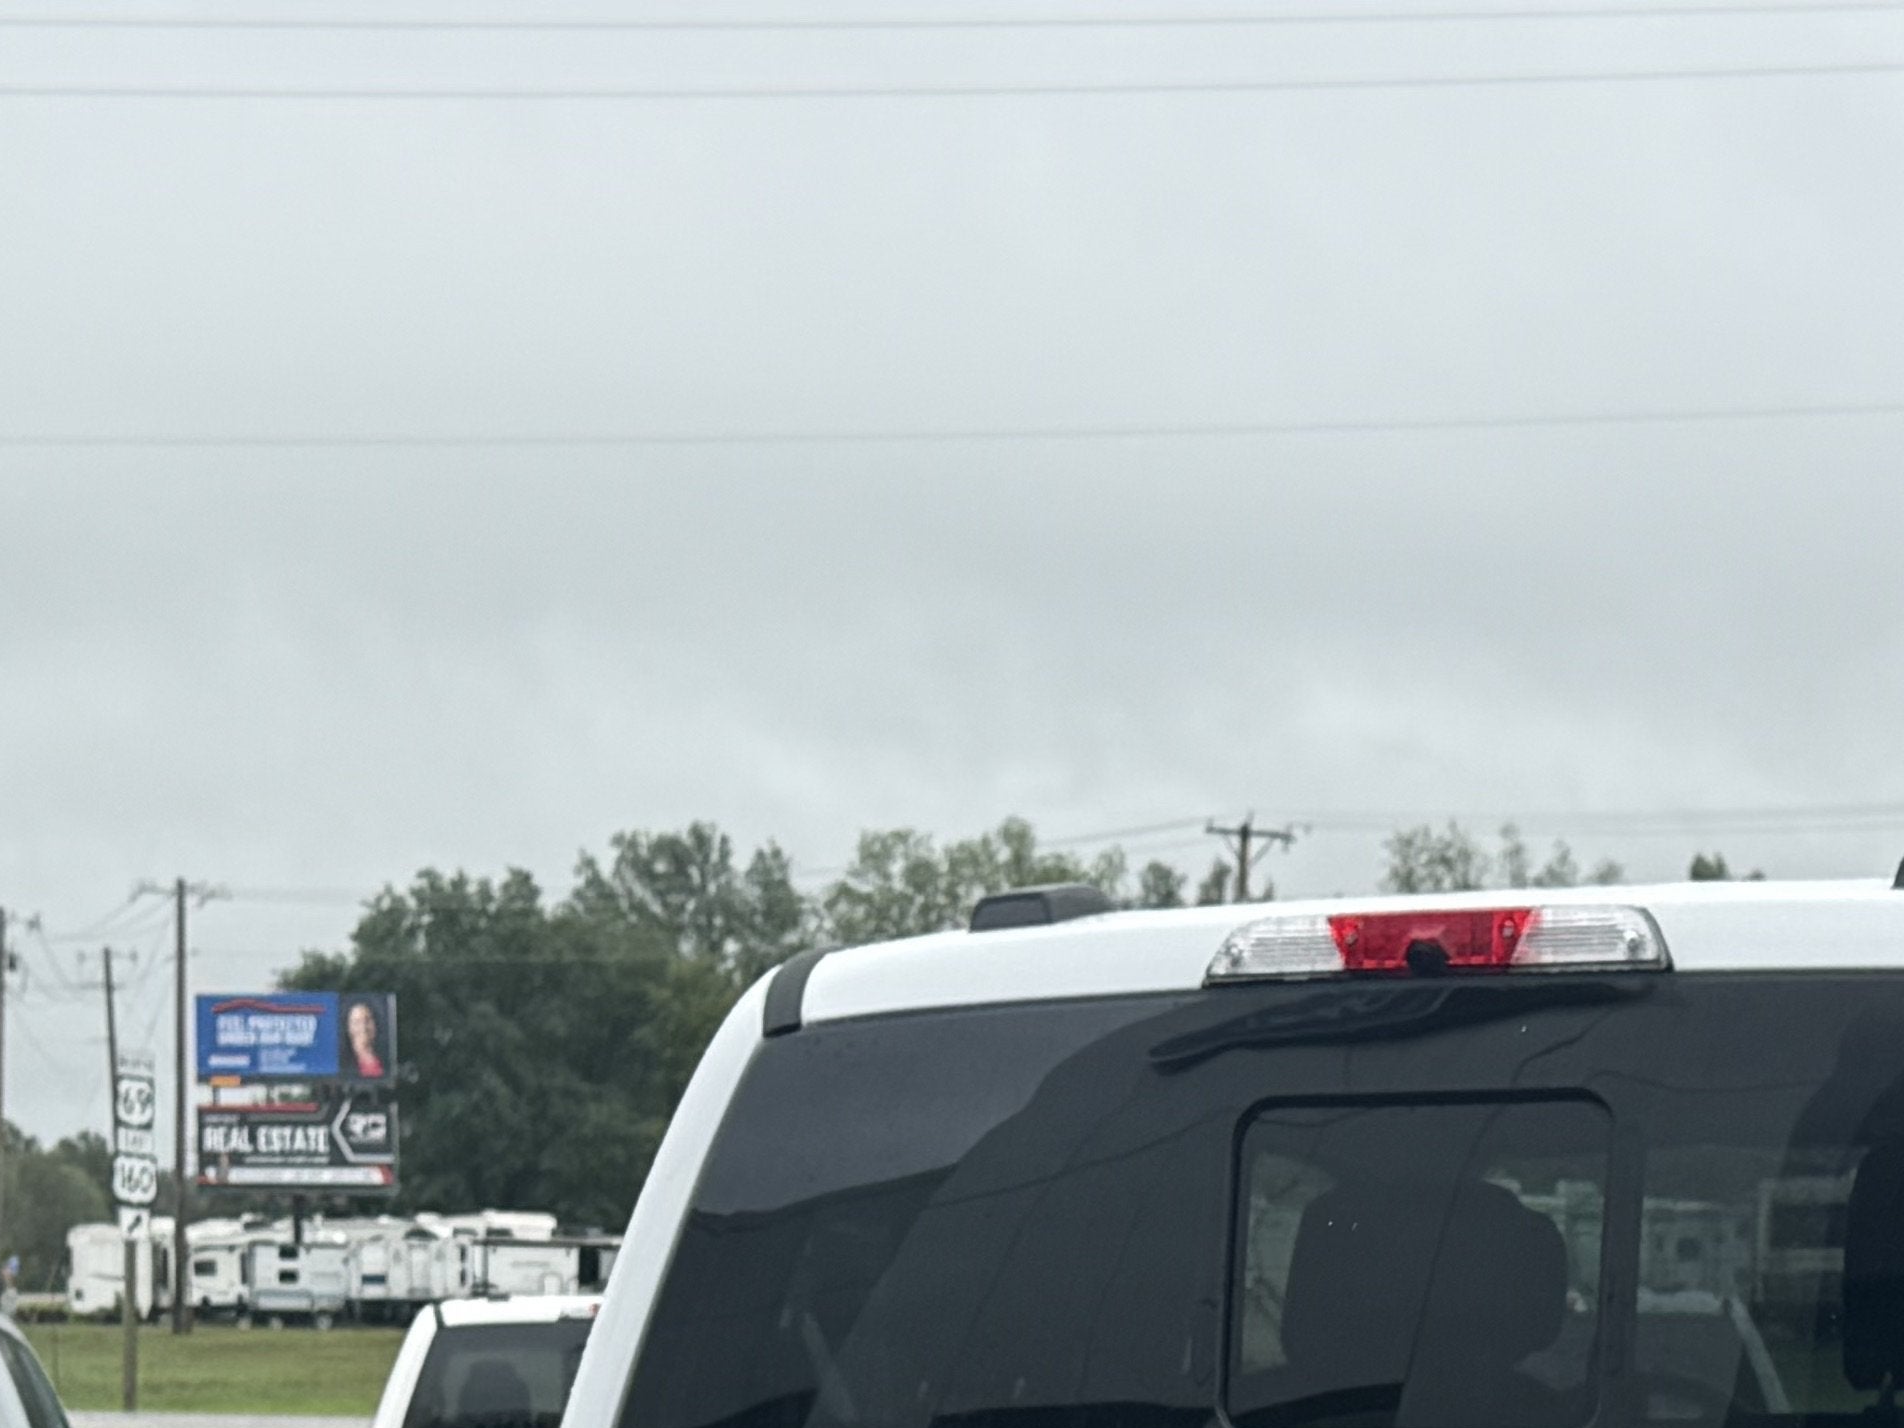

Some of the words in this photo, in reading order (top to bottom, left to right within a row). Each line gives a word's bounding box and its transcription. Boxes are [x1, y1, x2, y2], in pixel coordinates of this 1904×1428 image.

[122, 1086, 152, 1116] 69
[202, 1125, 253, 1153] REAL
[256, 1125, 330, 1153] ESTATE
[121, 1162, 154, 1193] 160
